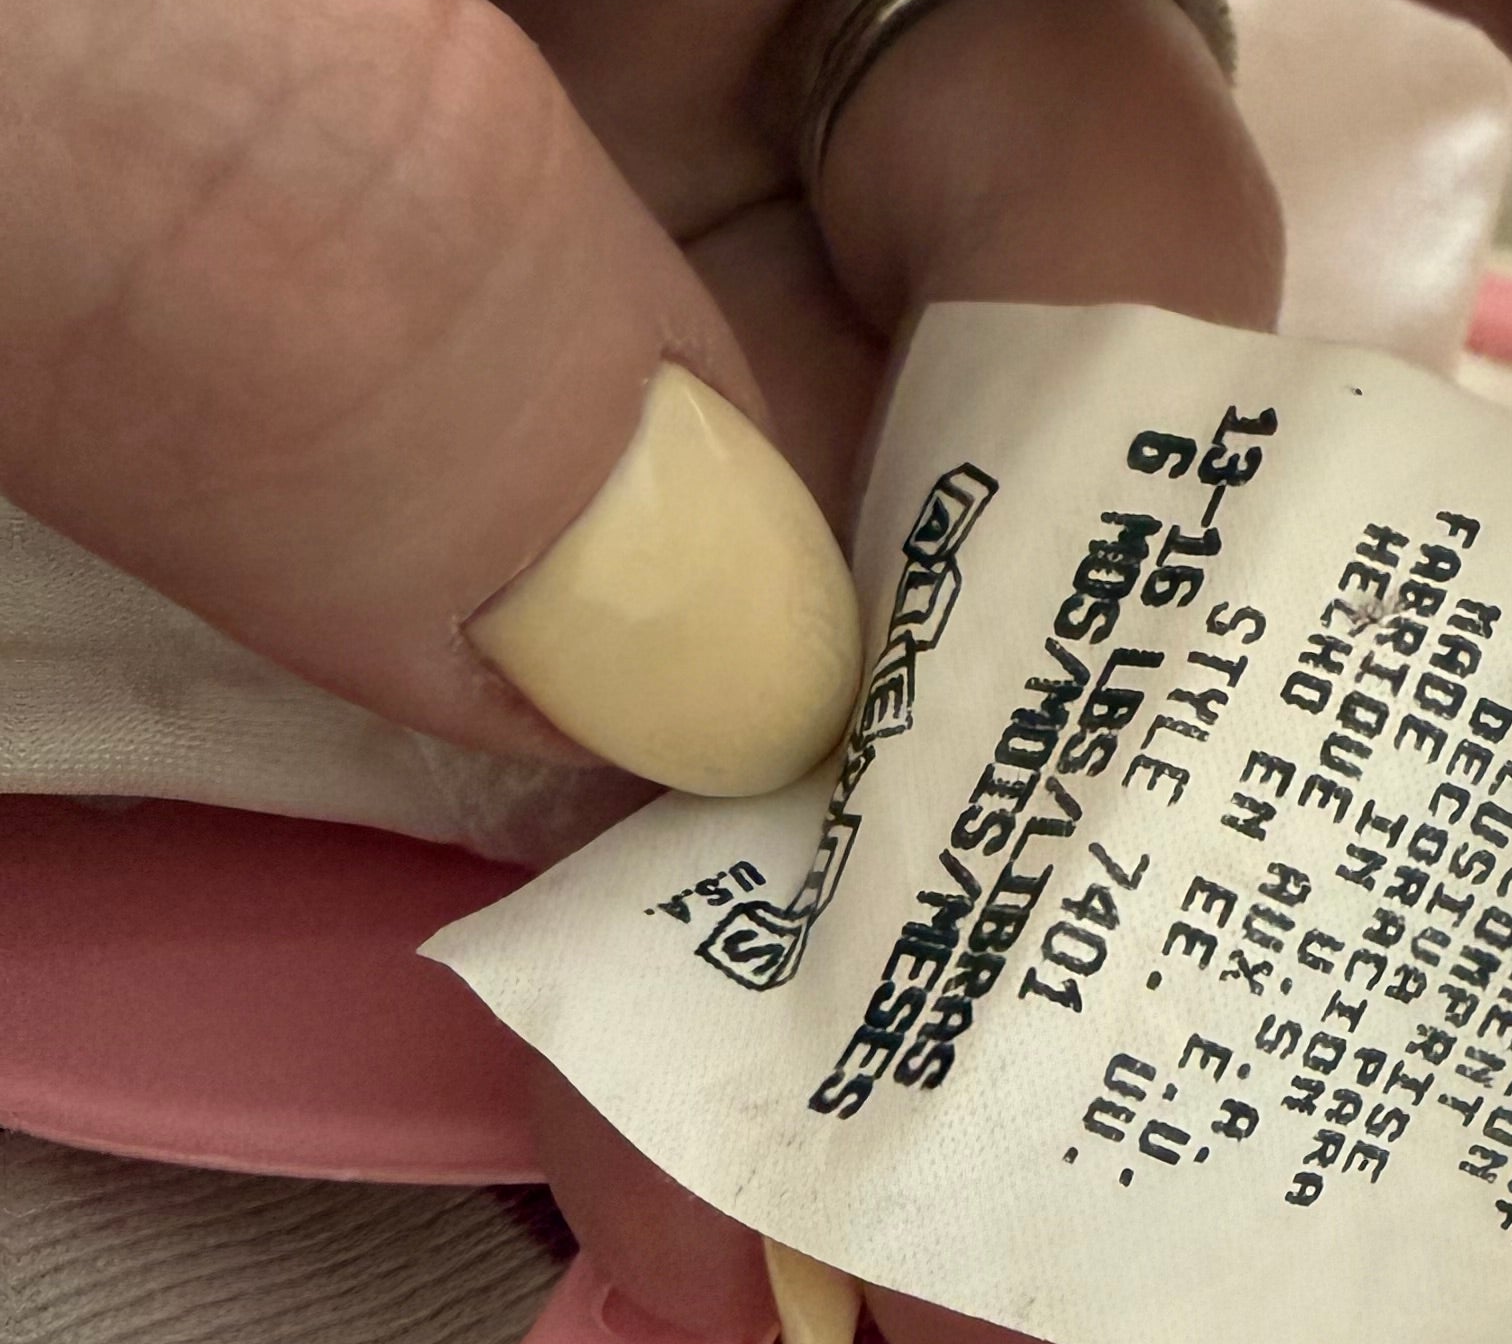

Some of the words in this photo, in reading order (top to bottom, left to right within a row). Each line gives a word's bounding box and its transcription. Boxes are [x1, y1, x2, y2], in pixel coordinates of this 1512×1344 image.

[1126, 430, 1198, 480] 6
[1139, 405, 1279, 609] 13-16
[1279, 523, 1410, 716] HECHO
[1297, 511, 1481, 824] FABRIQUE
[1393, 598, 1502, 765] MADE
[1121, 601, 1267, 807] STYLE
[807, 511, 1164, 1121] MOS/MOIS/MESES
[892, 647, 1166, 1091] LBS/LIBRAS
[1220, 749, 1297, 842] EN
[1335, 798, 1409, 893] IN
[643, 860, 767, 918] U.S.A.
[1017, 842, 1150, 1014] 7401
[1145, 875, 1239, 991] EE.
[1218, 861, 1312, 997] AUX
[1062, 1052, 1157, 1165] UU.
[1118, 1032, 1234, 1188] E.U.
[1193, 927, 1346, 1164] U.S.A.
[1284, 1046, 1388, 1207] PARA
